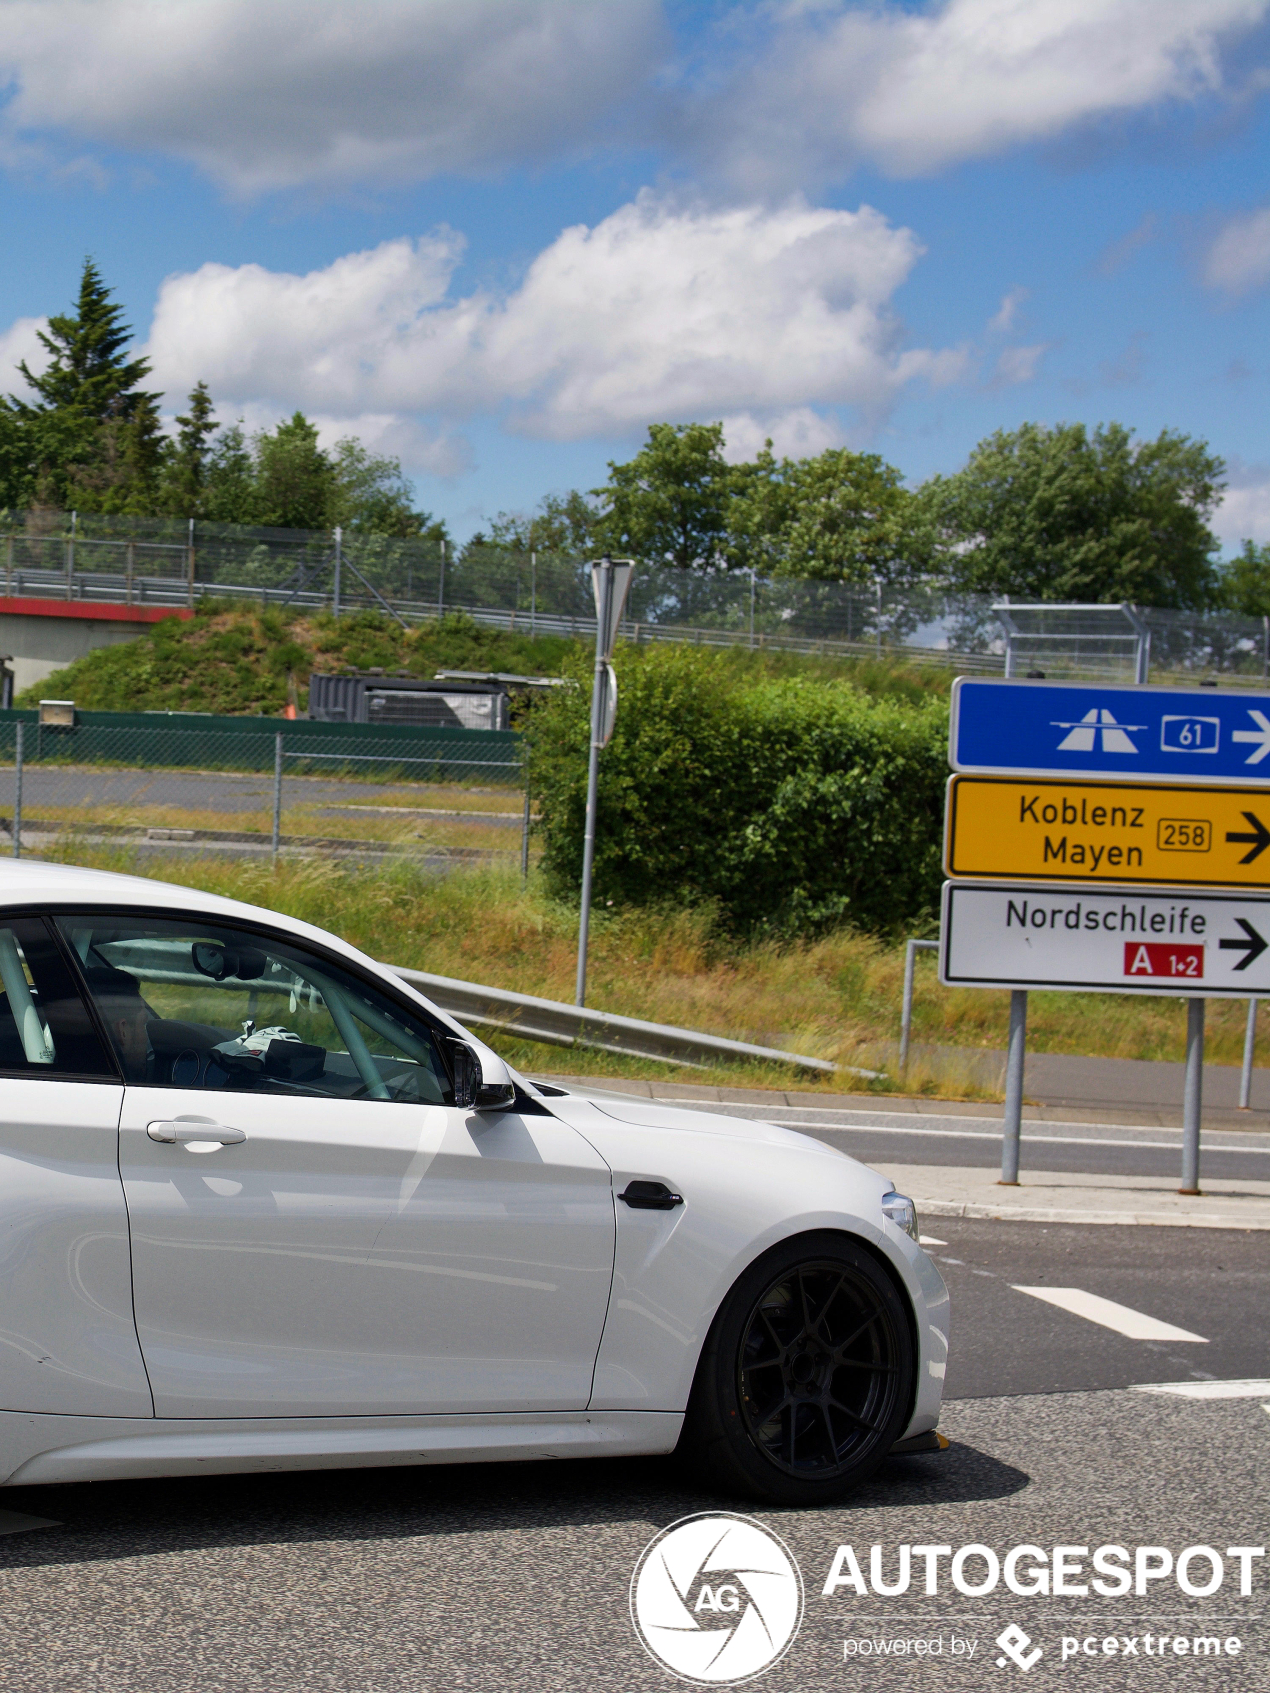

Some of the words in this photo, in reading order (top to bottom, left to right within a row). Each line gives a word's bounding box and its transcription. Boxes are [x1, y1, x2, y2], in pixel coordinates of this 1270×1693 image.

[1179, 723, 1202, 746] 61
[1019, 795, 1145, 828] Koblenz
[1163, 824, 1205, 847] 258
[1043, 836, 1143, 872] Mayen
[1006, 900, 1207, 935] Nordschleife
[1130, 945, 1153, 974] A
[1169, 954, 1199, 976] 1+2
